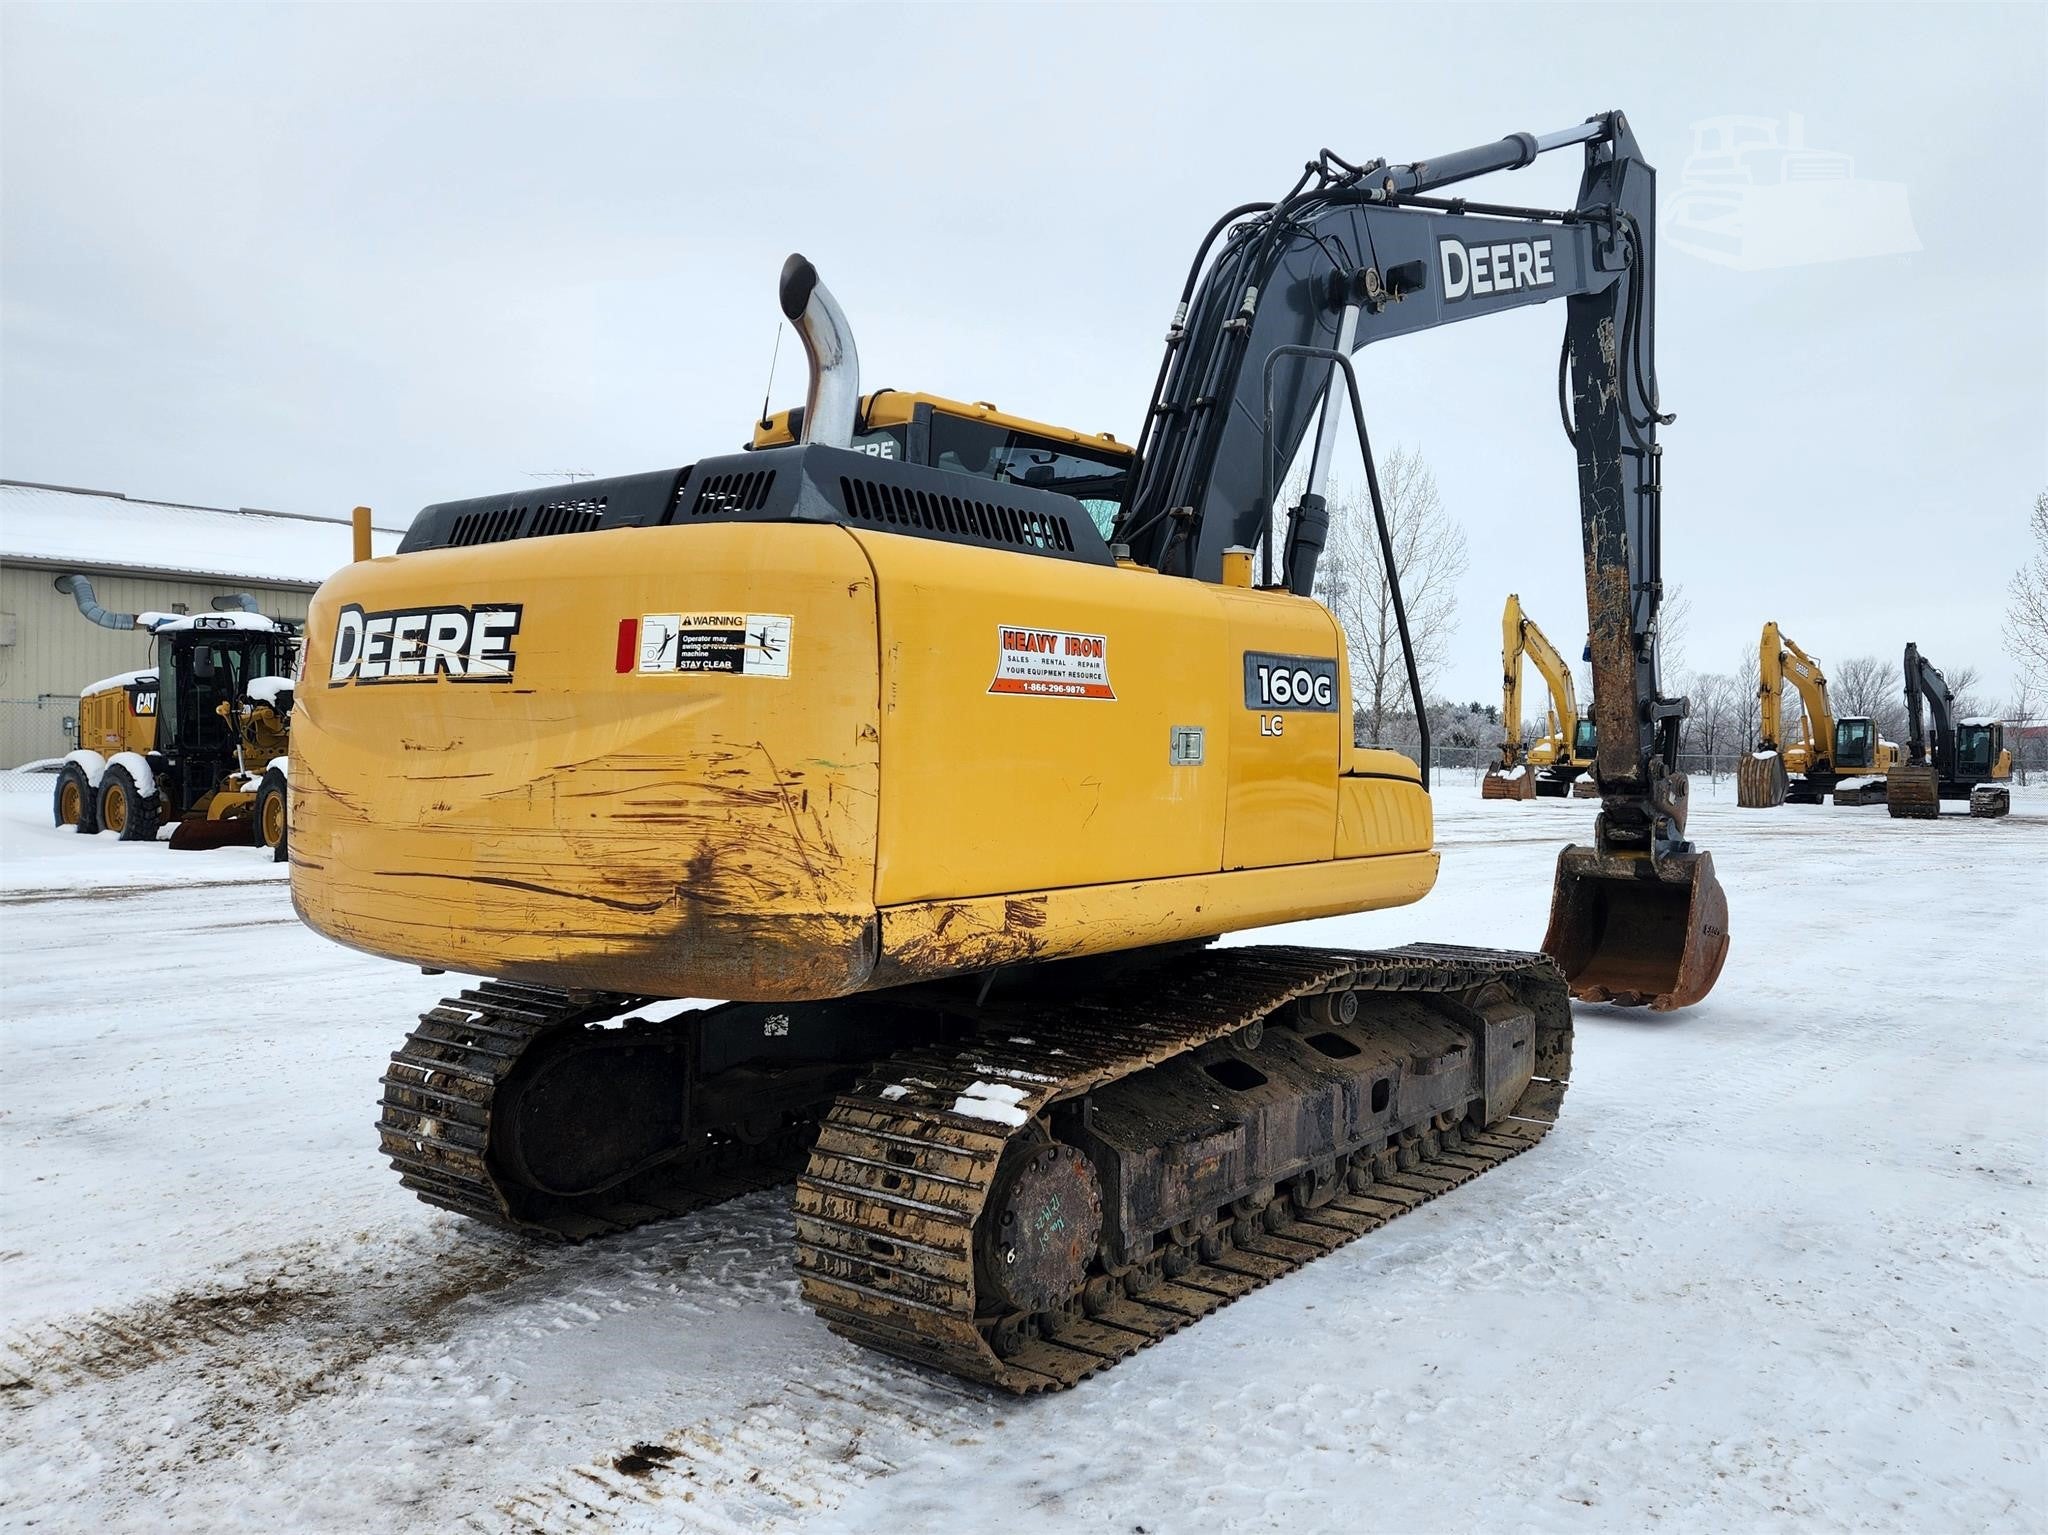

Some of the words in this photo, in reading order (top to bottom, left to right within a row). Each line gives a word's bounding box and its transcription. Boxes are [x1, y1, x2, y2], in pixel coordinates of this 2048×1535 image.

[1440, 239, 1554, 299] DEERE
[693, 616, 743, 626] WARNING
[330, 608, 518, 684] DEERE
[681, 643, 701, 651] swing
[1003, 630, 1058, 654] HEAVY
[1064, 636, 1103, 659] IRON
[680, 660, 701, 669] STAY
[702, 660, 733, 669] CLEAR
[1007, 655, 1030, 664] SALES
[1041, 658, 1066, 667] RENTAL
[1077, 661, 1100, 669] REPAIR
[1006, 666, 1026, 675] YOUR
[1027, 669, 1066, 678] EQUIPMENT
[1068, 671, 1102, 680] RESOURCE
[1023, 683, 1086, 694] 1-866-296-9876
[1258, 666, 1332, 706] 160G
[135, 692, 157, 714] CAT
[1261, 715, 1284, 737] LC
